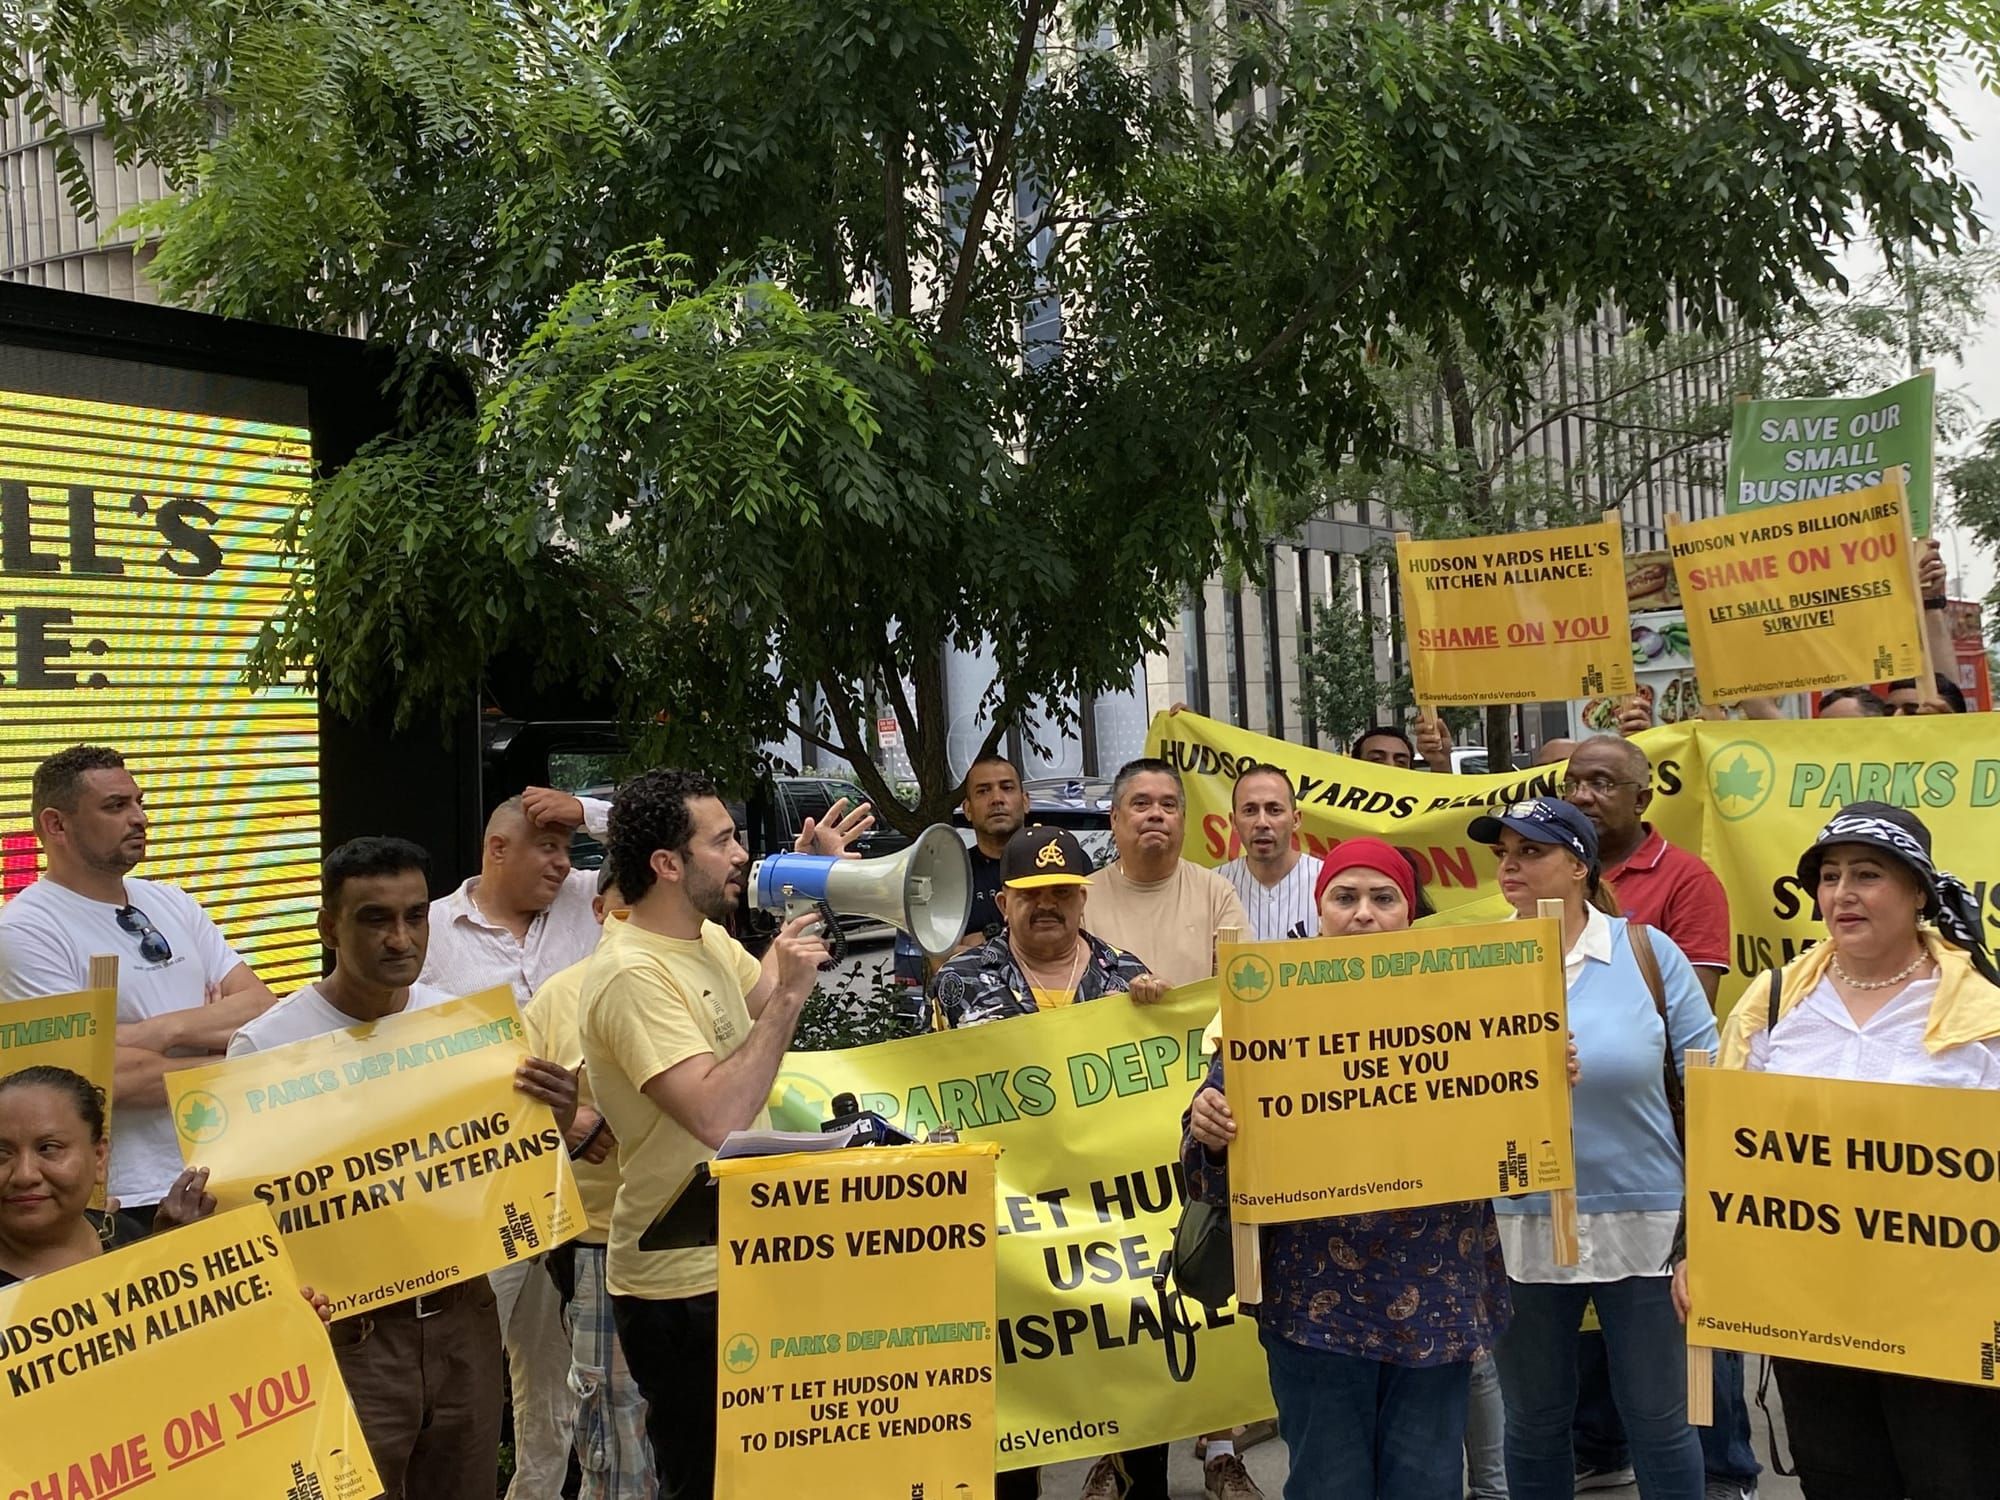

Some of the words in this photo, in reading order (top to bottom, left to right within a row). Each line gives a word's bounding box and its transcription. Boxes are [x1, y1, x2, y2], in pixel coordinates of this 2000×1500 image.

[1760, 417, 1839, 442] SAVE
[1849, 404, 1901, 437] OUR
[1784, 442, 1879, 472] SMALL
[1738, 462, 1912, 505] BUSINESSS
[1672, 531, 1735, 558] HUDSON
[1739, 523, 1793, 544] YARDS
[1798, 501, 1899, 534] BILLIONAIRES
[1408, 555, 1478, 573] HUDSON
[1483, 549, 1544, 568] YARDS
[1550, 541, 1610, 562] HELL'S
[1426, 571, 1497, 591] KITCHEN
[1503, 563, 1593, 586] ALLIANCE:
[1689, 555, 1779, 591] SHAME
[1788, 546, 1830, 575] ON
[1840, 532, 1897, 565] YOU
[1709, 605, 1734, 622] LET
[1738, 596, 1785, 616] SMALL
[1789, 580, 1892, 607] BUSINESSES
[1763, 609, 1835, 633] SURVIVE!
[0, 607, 109, 690] E:
[1418, 625, 1499, 649] SHAME
[1507, 622, 1545, 645] ON
[1553, 615, 1610, 642] YOU
[1712, 673, 1847, 698] #SaveHudsonYardsVendors
[1160, 739, 1258, 780] HUDSO
[1295, 774, 1419, 818] YARDS
[1789, 760, 1960, 809] PARKS
[1279, 957, 1365, 987] PARKS
[1371, 939, 1544, 979] DEPARTMENT:
[1229, 1036, 1310, 1063] DON'T
[1318, 1031, 1361, 1056] LET
[1368, 1020, 1472, 1051] HUDSON
[1478, 1011, 1560, 1038] YARDS
[246, 1067, 340, 1114] PARKS
[343, 1015, 524, 1086] DEPARTMENT:
[1343, 1056, 1390, 1081] USE
[1398, 1050, 1450, 1075] YOU
[860, 1065, 1057, 1138] PARKS
[1257, 1096, 1293, 1119] TO
[1301, 1082, 1418, 1115] DISPLACE
[1425, 1069, 1540, 1101] VENDORS
[253, 1164, 335, 1207] STOP
[343, 1111, 511, 1183] DISPLACING
[415, 1128, 561, 1194] VETERANS
[1506, 1139, 1518, 1179] JUSTICE
[1517, 1152, 1528, 1187] CENTER
[1733, 1127, 1832, 1167] SAVE
[1846, 1138, 2000, 1183] HUDSO
[750, 1178, 831, 1209] SAVE
[841, 1169, 967, 1203] HUDSON
[1231, 1178, 1424, 1206] #SaveHudsonYardsVendors
[1498, 1160, 1510, 1192] URBAN
[503, 1201, 525, 1241] JUSTICE
[519, 1211, 540, 1248] CENTER
[1709, 1190, 1841, 1235] YARDS
[498, 1225, 519, 1260] URBAN
[729, 1234, 835, 1266] YARDS
[845, 1223, 987, 1257] VENDORS
[1043, 1234, 1156, 1291] USE
[102, 1262, 199, 1318] YARDS
[202, 1234, 279, 1282] HELL'S
[6, 1323, 137, 1398] KITCHEN
[146, 1274, 273, 1345] ALLIANCE:
[770, 1333, 841, 1359] PARKS
[846, 1321, 992, 1351] DEPARTMENT:
[1696, 1316, 1906, 1355] #SaveHudsonYardsVendors
[1981, 1342, 1994, 1380] URBAN
[721, 1384, 785, 1410] DON'T
[790, 1380, 827, 1401] LET
[832, 1371, 919, 1397] HUDSON
[925, 1366, 993, 1388] YARDS
[810, 1402, 849, 1421] USE
[857, 1396, 900, 1418] YOU
[163, 1403, 223, 1461] ON
[229, 1363, 312, 1429] YOU
[740, 1432, 768, 1453] TO
[774, 1423, 871, 1450] DISPLACE
[878, 1412, 973, 1438] VENDORS
[995, 1420, 1120, 1454] dsVendors
